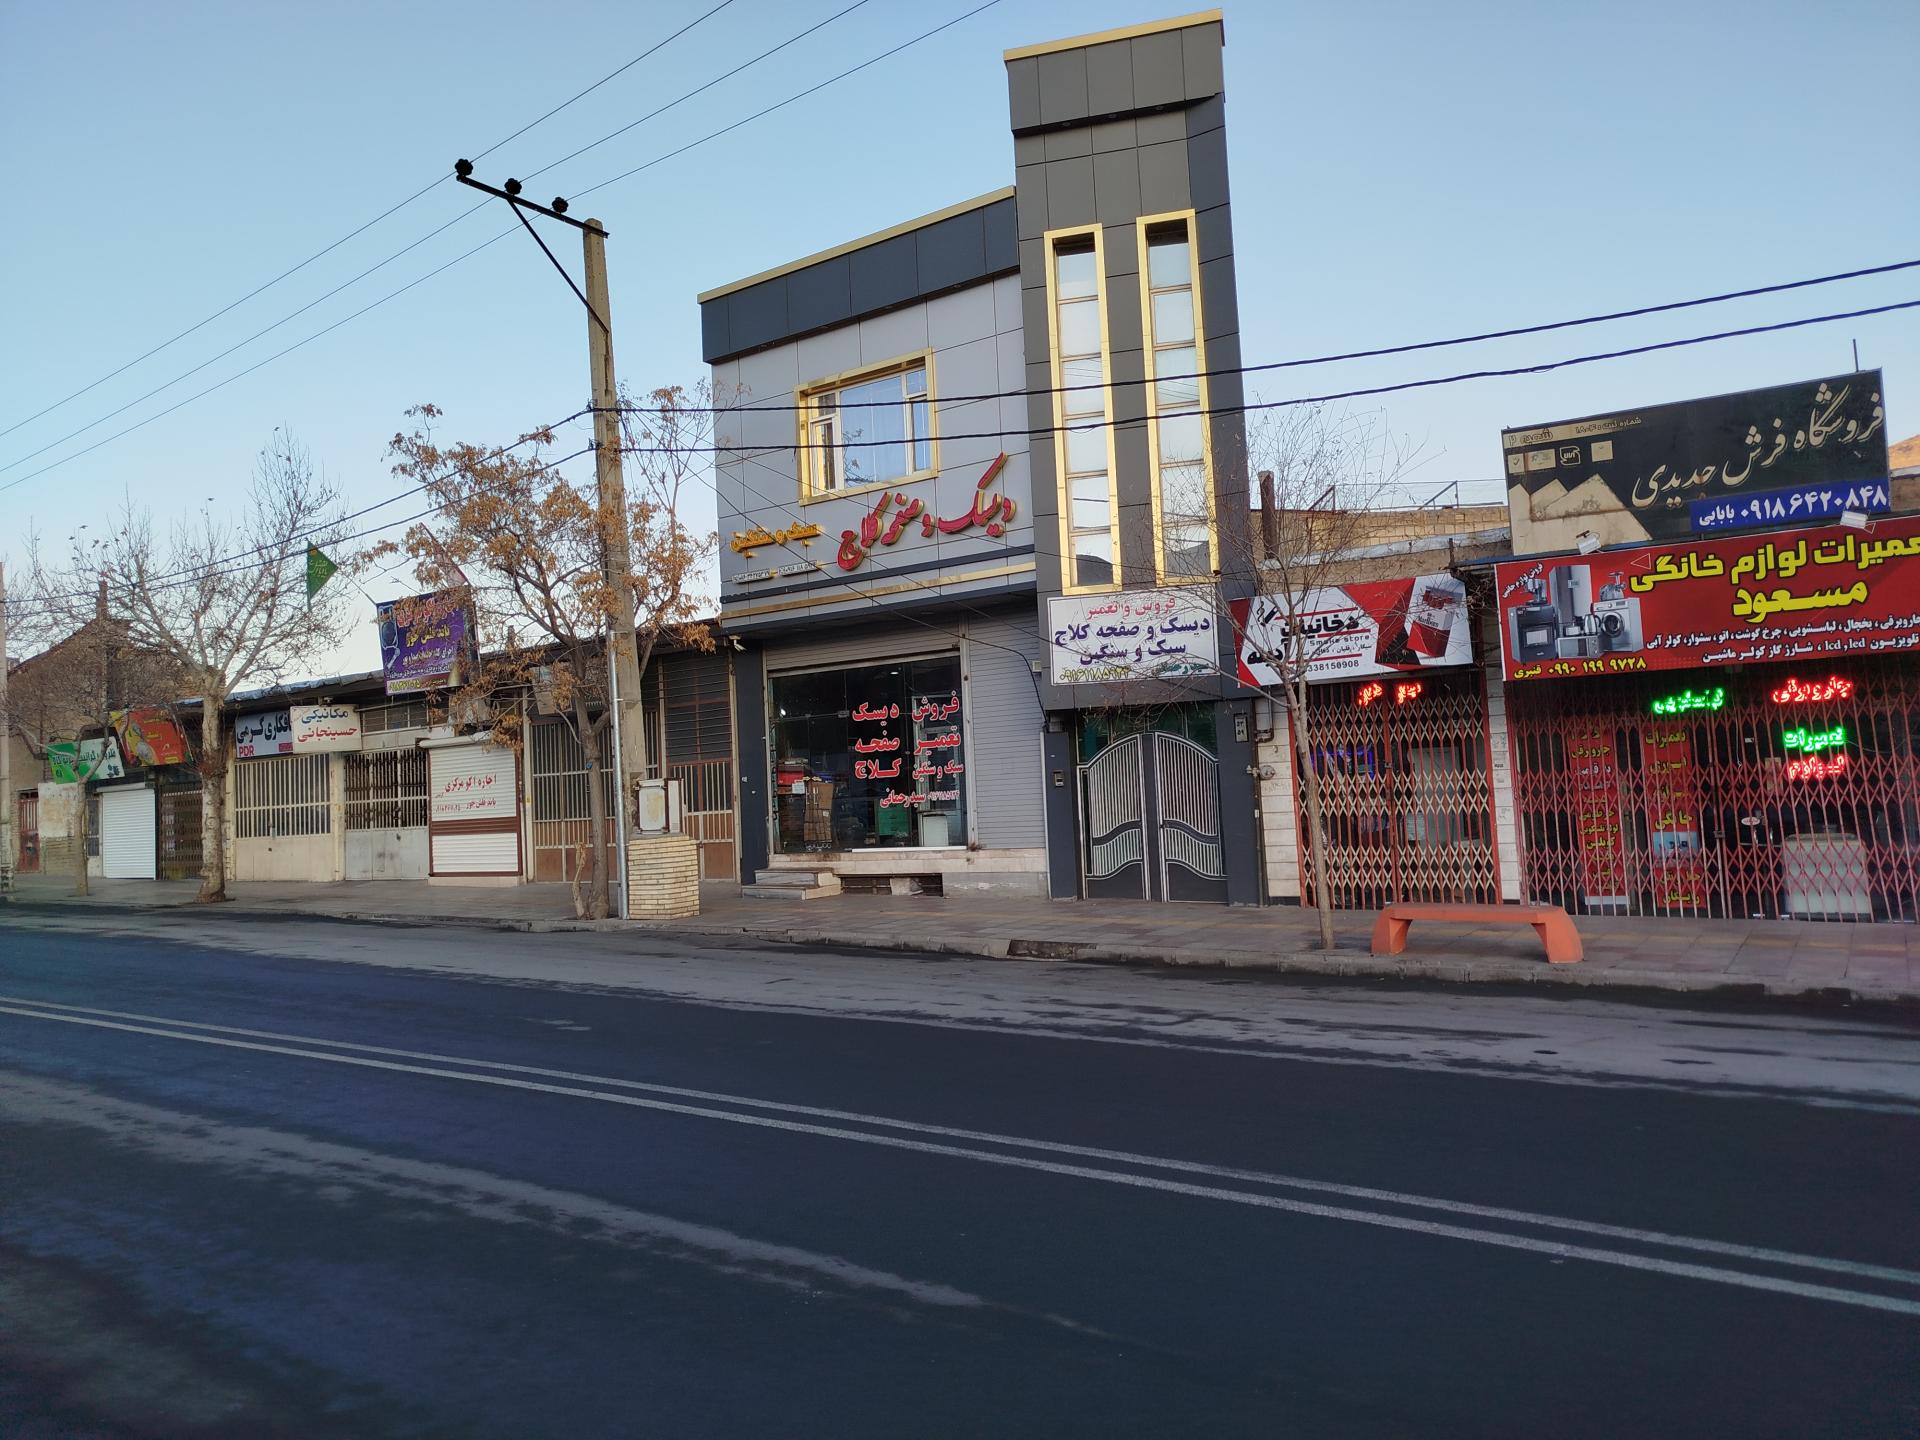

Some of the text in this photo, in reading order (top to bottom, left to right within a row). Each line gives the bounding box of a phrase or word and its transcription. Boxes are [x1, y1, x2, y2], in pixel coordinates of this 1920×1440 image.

[1632, 383, 1883, 508] فروشگاه فرش حدیدی
[1699, 485, 1889, 527] بابایی ۰۹۱۸۶۴۲۰۸۴۸
[1630, 533, 1920, 592] عمیرات لوازم خانگی
[1123, 604, 1131, 616] و
[1731, 582, 1869, 623] مسعود
[1055, 616, 1211, 646] دیسک و صفحه کلاج
[1844, 618, 1873, 632] یخچال
[1646, 634, 1662, 649] آبی
[1664, 634, 1682, 648] کولر
[1718, 630, 1729, 643] اتو
[1762, 627, 1782, 640] چرخ
[1133, 645, 1143, 662] و
[1148, 639, 1187, 656] سبک
[1702, 648, 1737, 663] ماشین
[1738, 645, 1766, 660] کولر
[1768, 644, 1783, 658] گاز
[1784, 641, 1814, 657] شارژ
[1514, 664, 1542, 679] قنبری
[1548, 662, 1576, 675] ۰۹۹۰
[1582, 660, 1605, 673] ۱۹۹
[301, 708, 349, 724] مکانیکی
[852, 690, 960, 726] فروش دیسک
[265, 711, 292, 741] افکاری
[855, 725, 961, 756] تعمیر صفحه
[239, 745, 254, 757] PDR
[855, 757, 964, 782] سبک و سنگین کلاج
